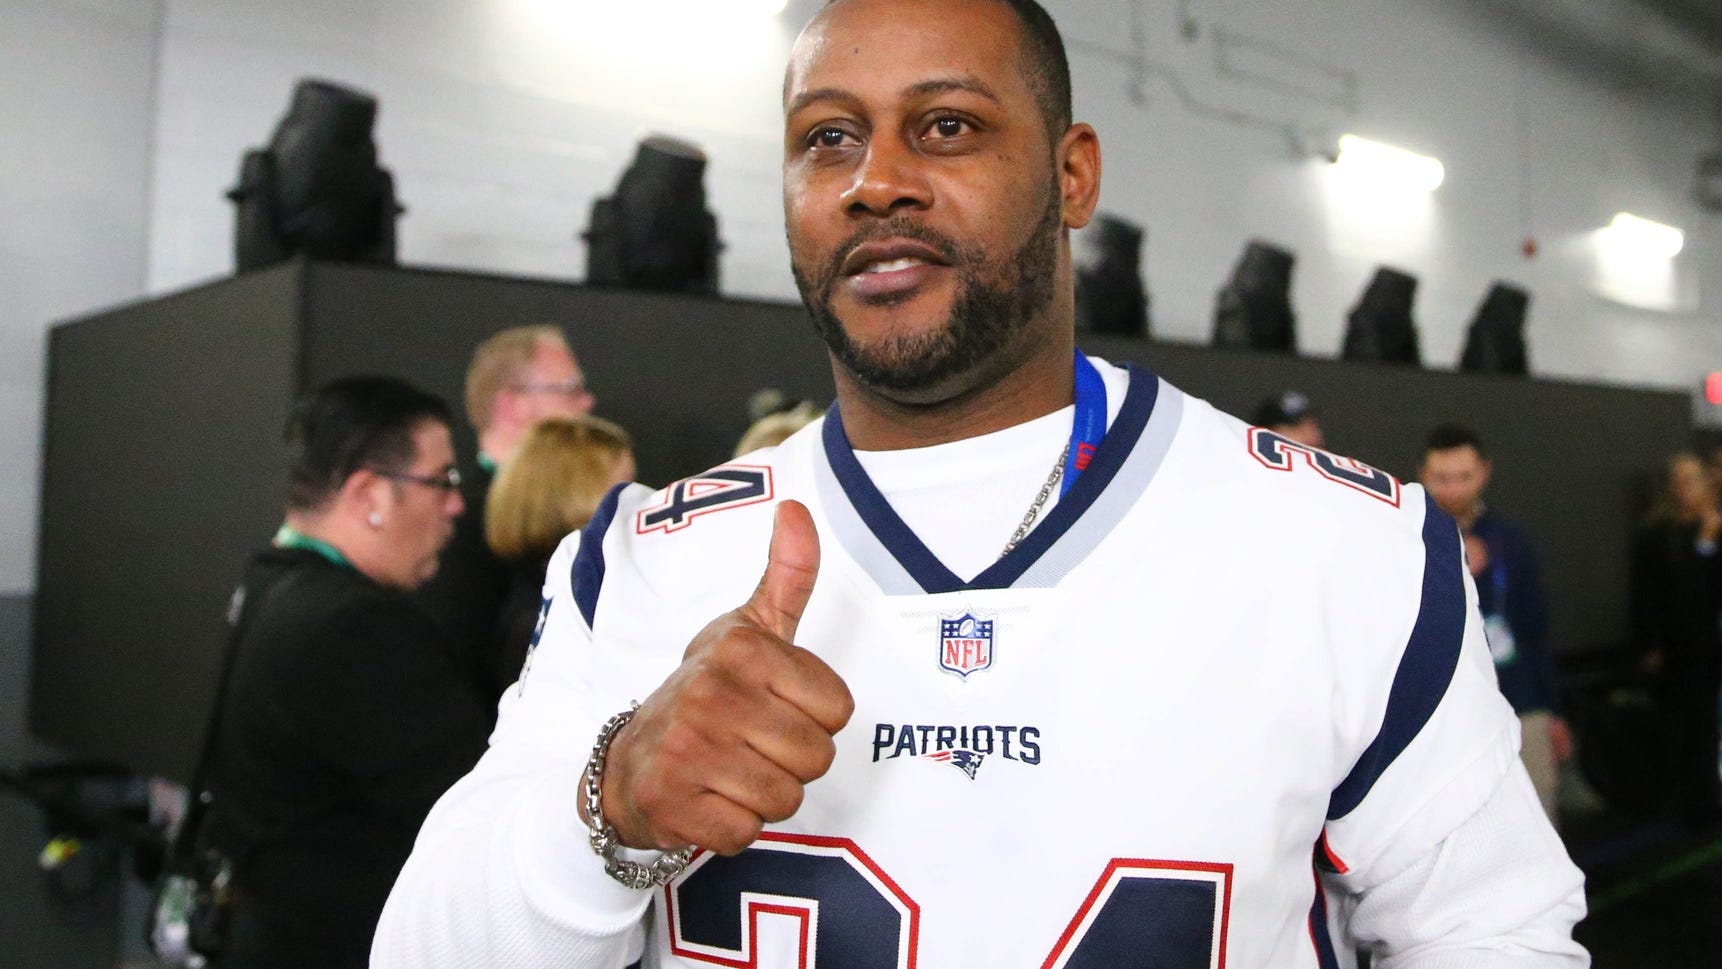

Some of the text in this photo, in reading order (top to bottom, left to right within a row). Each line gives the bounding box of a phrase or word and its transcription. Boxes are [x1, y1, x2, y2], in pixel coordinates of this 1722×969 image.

[636, 464, 774, 535] 4
[945, 639, 988, 669] NFL
[872, 723, 1041, 766] PATRIOTS
